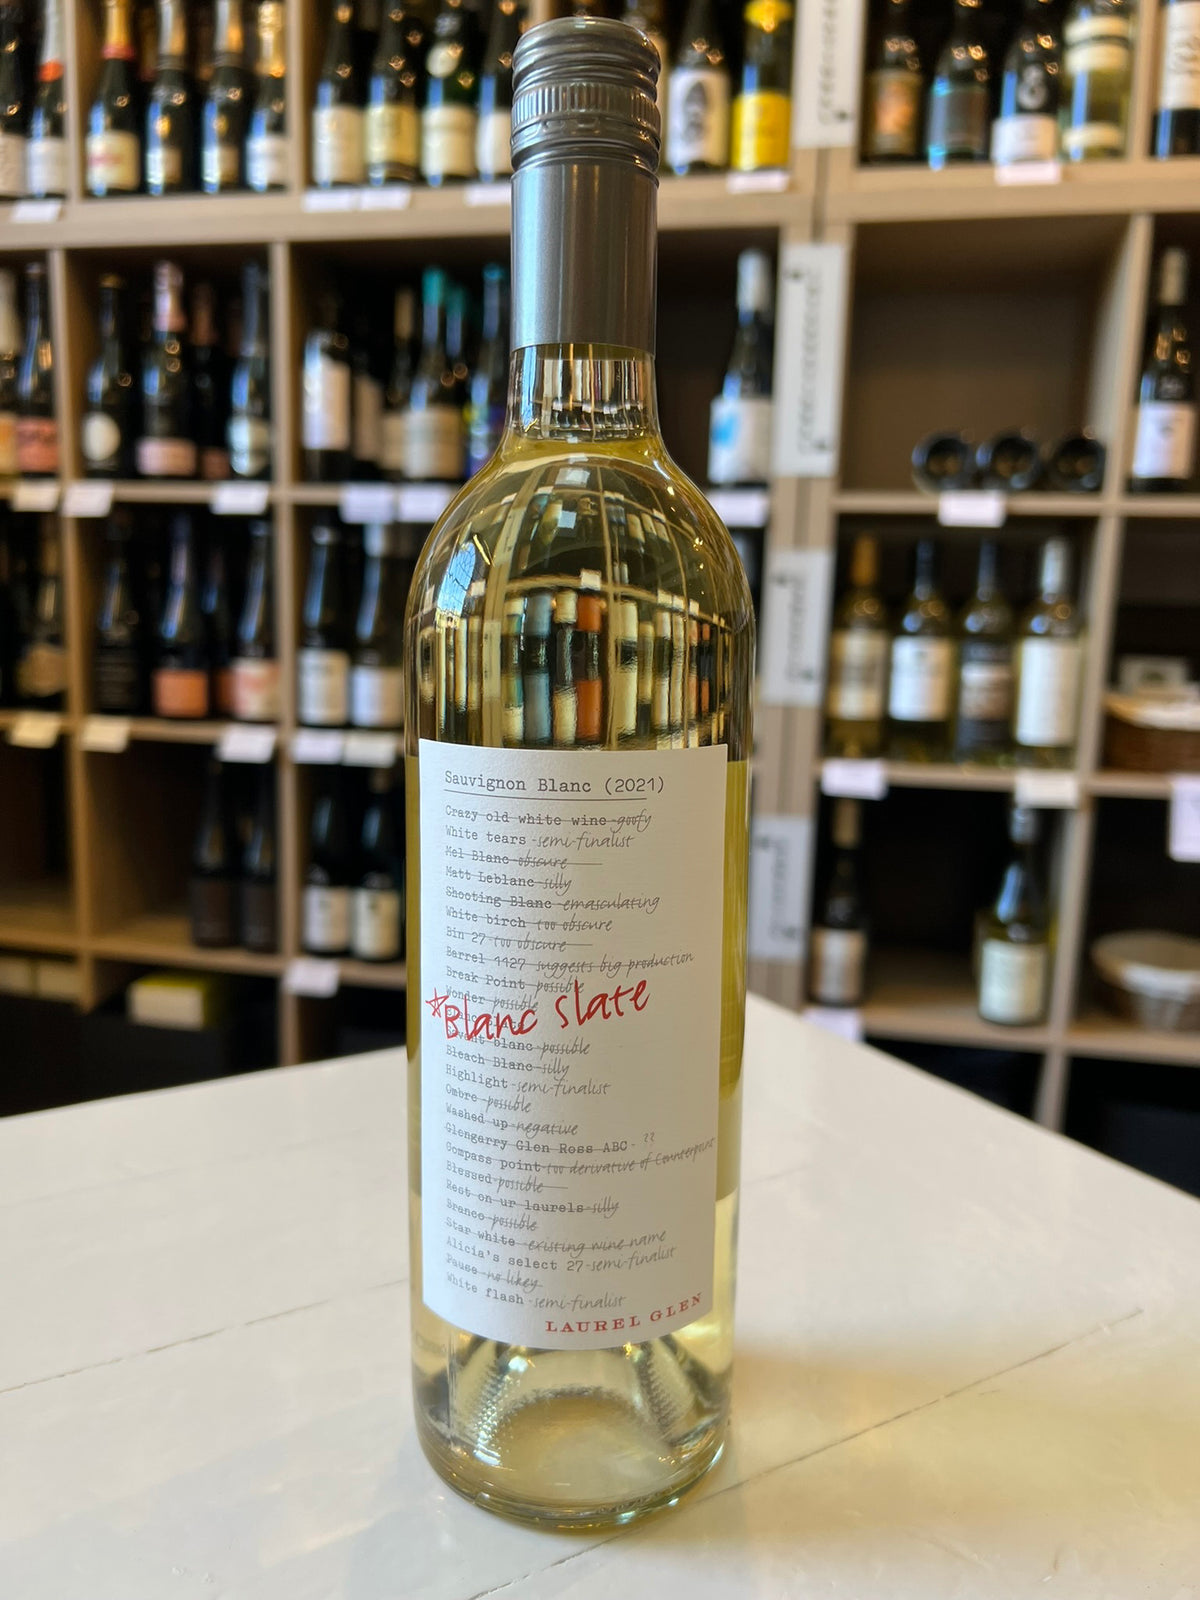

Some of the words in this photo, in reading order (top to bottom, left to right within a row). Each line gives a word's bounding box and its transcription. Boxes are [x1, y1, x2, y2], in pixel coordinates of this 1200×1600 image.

[445, 770, 526, 791] Sauvignon
[538, 778, 592, 793] Blanc
[605, 775, 665, 795] (2021)
[445, 805, 478, 822] Crazy
[486, 809, 510, 823] old
[518, 812, 562, 826] white
[571, 813, 607, 826] wine
[446, 825, 478, 840] White
[486, 828, 526, 845] tears
[445, 846, 465, 859] Mel
[472, 850, 511, 865] Blanc
[445, 865, 471, 880] Matt
[478, 871, 535, 887] Leblanc
[445, 885, 502, 907] Shooting
[510, 895, 552, 909] Blanc
[563, 893, 660, 914] emasculating
[446, 906, 478, 922] White
[486, 914, 526, 928] birch
[563, 914, 613, 932] obscure
[446, 926, 465, 940] Bin
[471, 932, 486, 945] 27
[517, 932, 567, 952] obscure
[446, 946, 485, 964] Barrel
[536, 960, 593, 979] suggests
[600, 954, 622, 978] big
[626, 949, 694, 978] production
[446, 966, 479, 983] Break
[485, 974, 526, 989] Point
[444, 995, 538, 1041] Blanc
[493, 1036, 533, 1051] blanc
[446, 1044, 485, 1065] Bleach
[494, 1057, 533, 1072] Blanc
[446, 1064, 508, 1088] Highlight
[445, 1083, 477, 1102] Ombre
[445, 1103, 485, 1124] Washed
[493, 1118, 509, 1130] up
[445, 1122, 508, 1150] Glengarry
[516, 1140, 550, 1153] Glen
[559, 1140, 593, 1154] Ross
[603, 1140, 628, 1153] ABC
[446, 1141, 493, 1165] Compass
[500, 1159, 541, 1173] point
[569, 1160, 635, 1176] derivative
[640, 1152, 653, 1171] of
[446, 1160, 493, 1184] Blessed
[446, 1179, 471, 1197] Rest
[478, 1193, 493, 1204] on
[500, 1199, 517, 1208] ur
[524, 1200, 584, 1213] laurels
[446, 1198, 485, 1220] Branco
[446, 1217, 471, 1235] Star
[477, 1230, 516, 1247] white
[528, 1236, 585, 1258] existing
[591, 1238, 624, 1251] wine
[629, 1230, 667, 1247] name
[446, 1236, 500, 1262] Alicia's
[508, 1256, 558, 1271] select
[566, 1260, 584, 1272] 27
[446, 1253, 478, 1275] Pause
[446, 1271, 478, 1293] White
[486, 1287, 524, 1304] flash
[546, 1315, 640, 1333] LAUREL
[650, 1291, 704, 1322] GLEN
